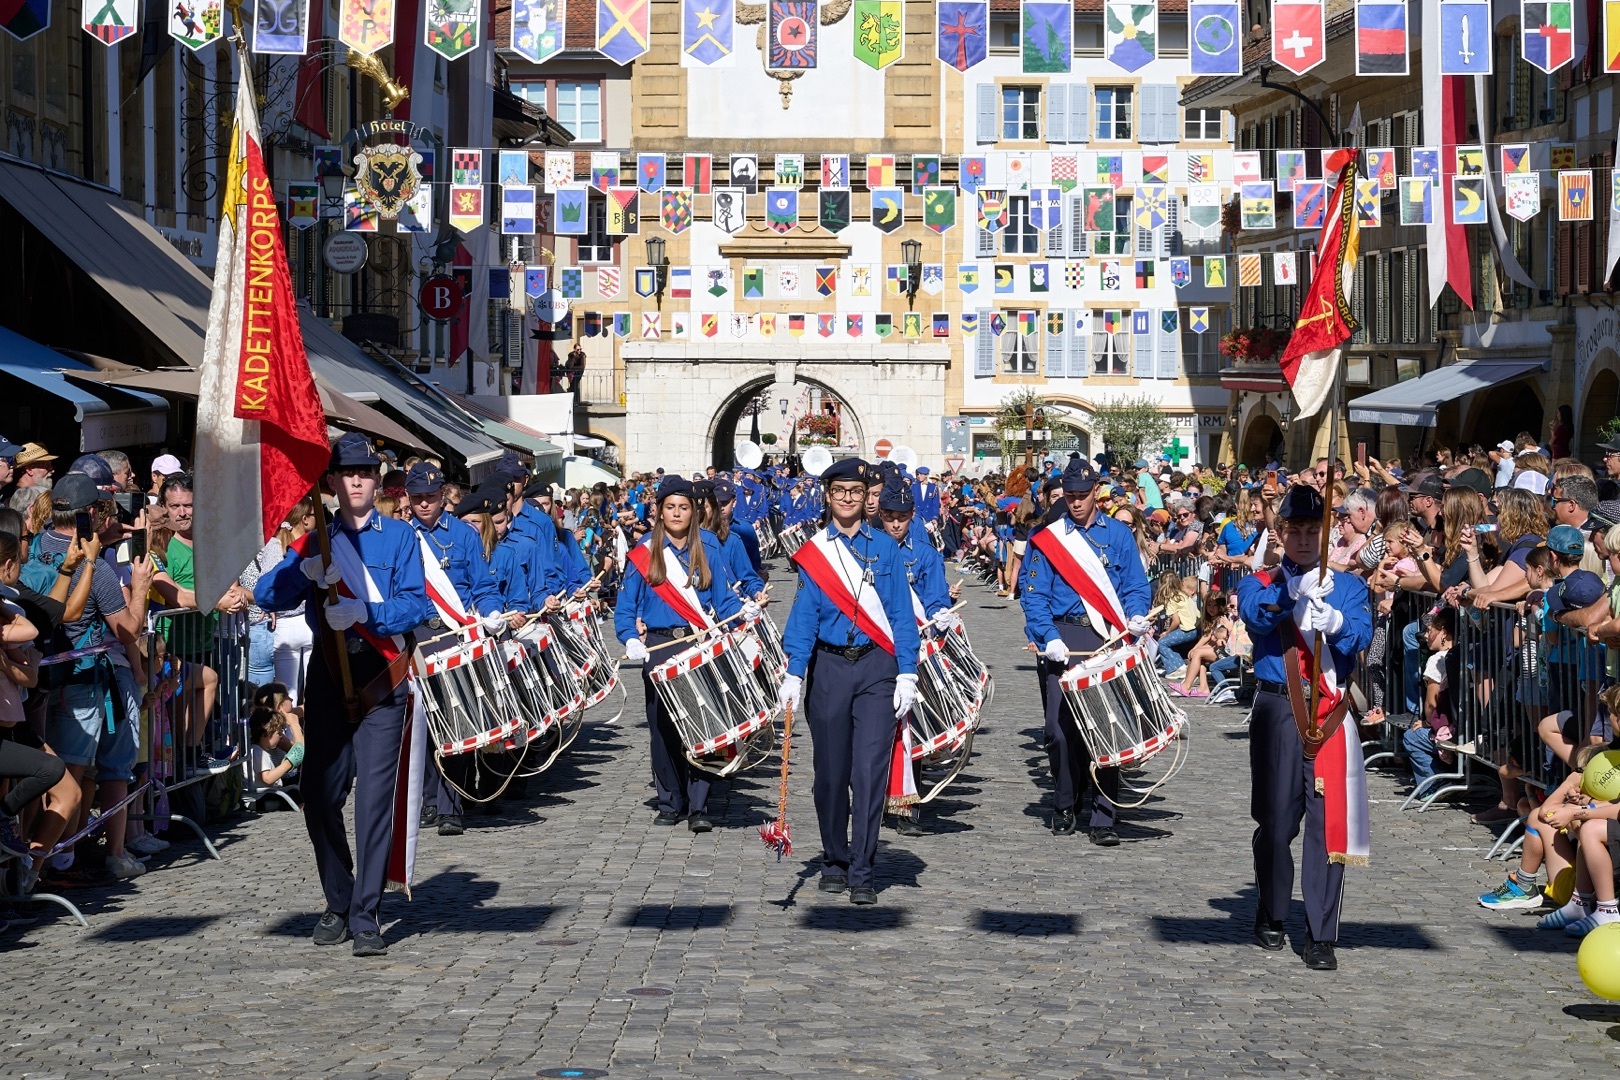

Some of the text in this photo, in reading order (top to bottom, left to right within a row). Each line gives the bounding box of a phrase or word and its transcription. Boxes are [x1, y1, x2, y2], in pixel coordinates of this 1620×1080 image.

[370, 120, 406, 133] Hotel
[241, 177, 276, 410] KADETTENKORPS
[433, 286, 451, 309] B
[548, 301, 566, 310] UBS
